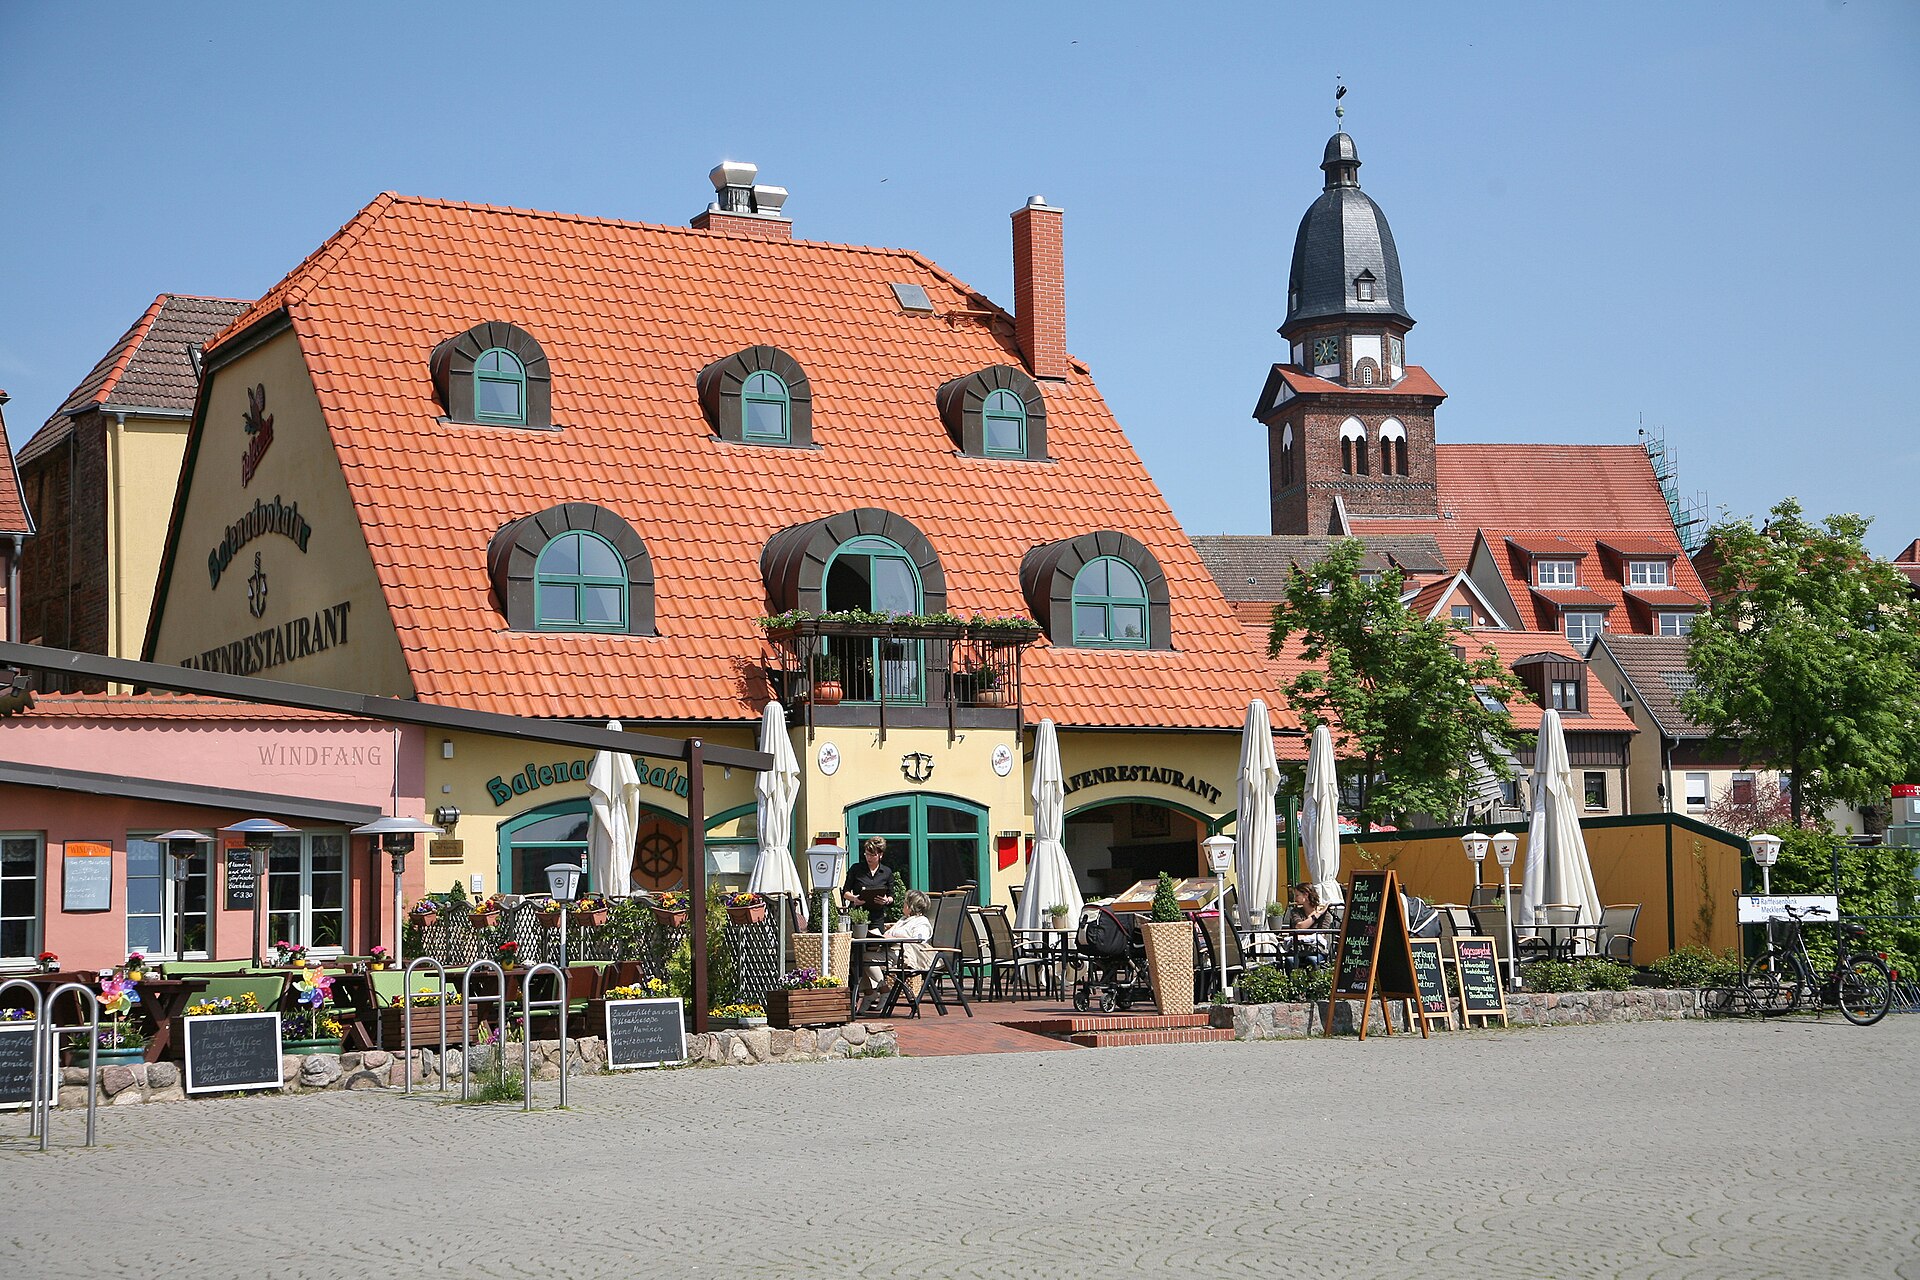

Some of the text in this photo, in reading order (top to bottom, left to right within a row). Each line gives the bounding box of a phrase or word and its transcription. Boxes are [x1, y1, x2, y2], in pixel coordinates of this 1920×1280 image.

[208, 495, 312, 590] Hafenadvokatur
[258, 743, 382, 766] WINDFANG
[487, 757, 689, 807] Hafenakatu
[1063, 765, 1222, 805] AFENRESTAURANT
[1761, 898, 1797, 906] Raiffeisenbank
[201, 1038, 226, 1049] Tasse
[229, 1036, 262, 1049] Kaffee
